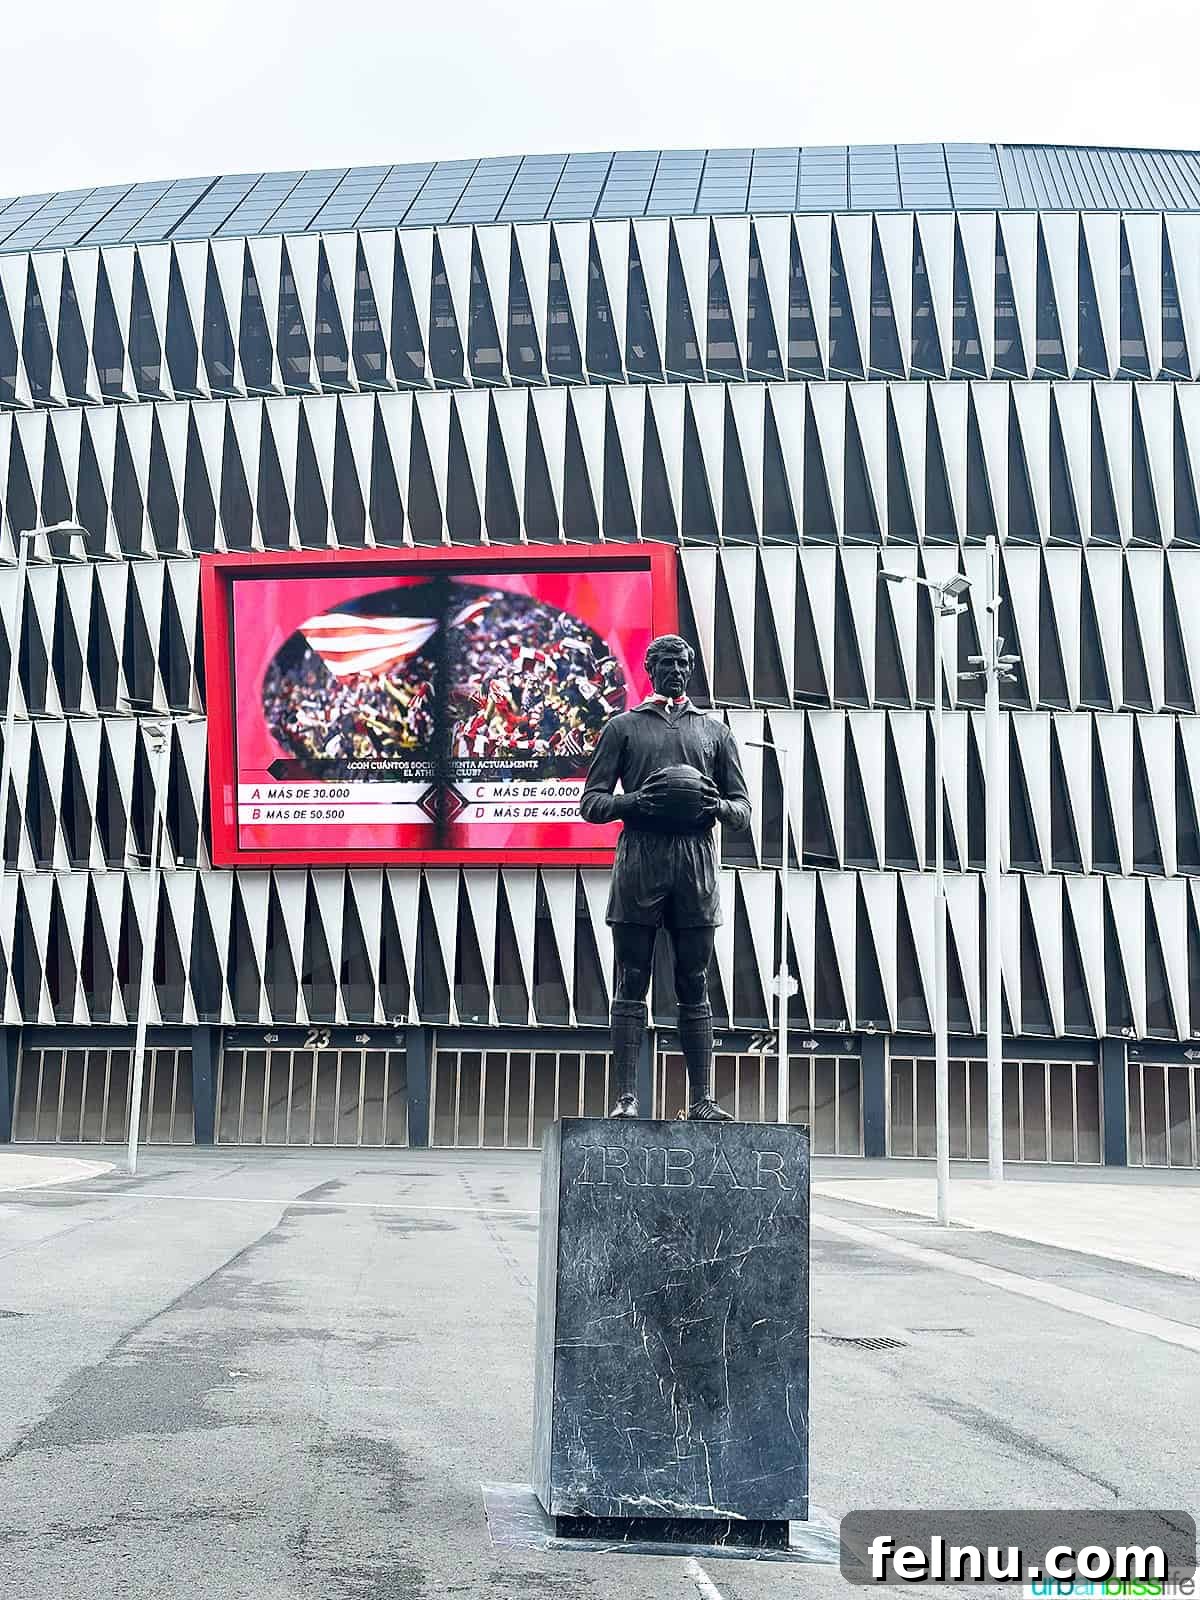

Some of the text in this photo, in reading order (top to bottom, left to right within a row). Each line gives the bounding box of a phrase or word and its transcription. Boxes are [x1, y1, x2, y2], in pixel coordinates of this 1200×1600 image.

[410, 761, 440, 769] SOCIO
[477, 760, 539, 769] ACTUALMENTE
[403, 769, 414, 777] EL
[251, 786, 350, 799] A MÁS DE 30.000
[475, 785, 580, 798] C MÁS DE 40.000
[252, 808, 261, 820] B
[293, 809, 307, 819] DE
[310, 809, 345, 820] 50.500
[475, 805, 581, 818] D MÁS DE 44.500
[303, 1029, 332, 1049] 23
[747, 1034, 778, 1054] 22
[573, 1144, 793, 1191] IRIBAR
